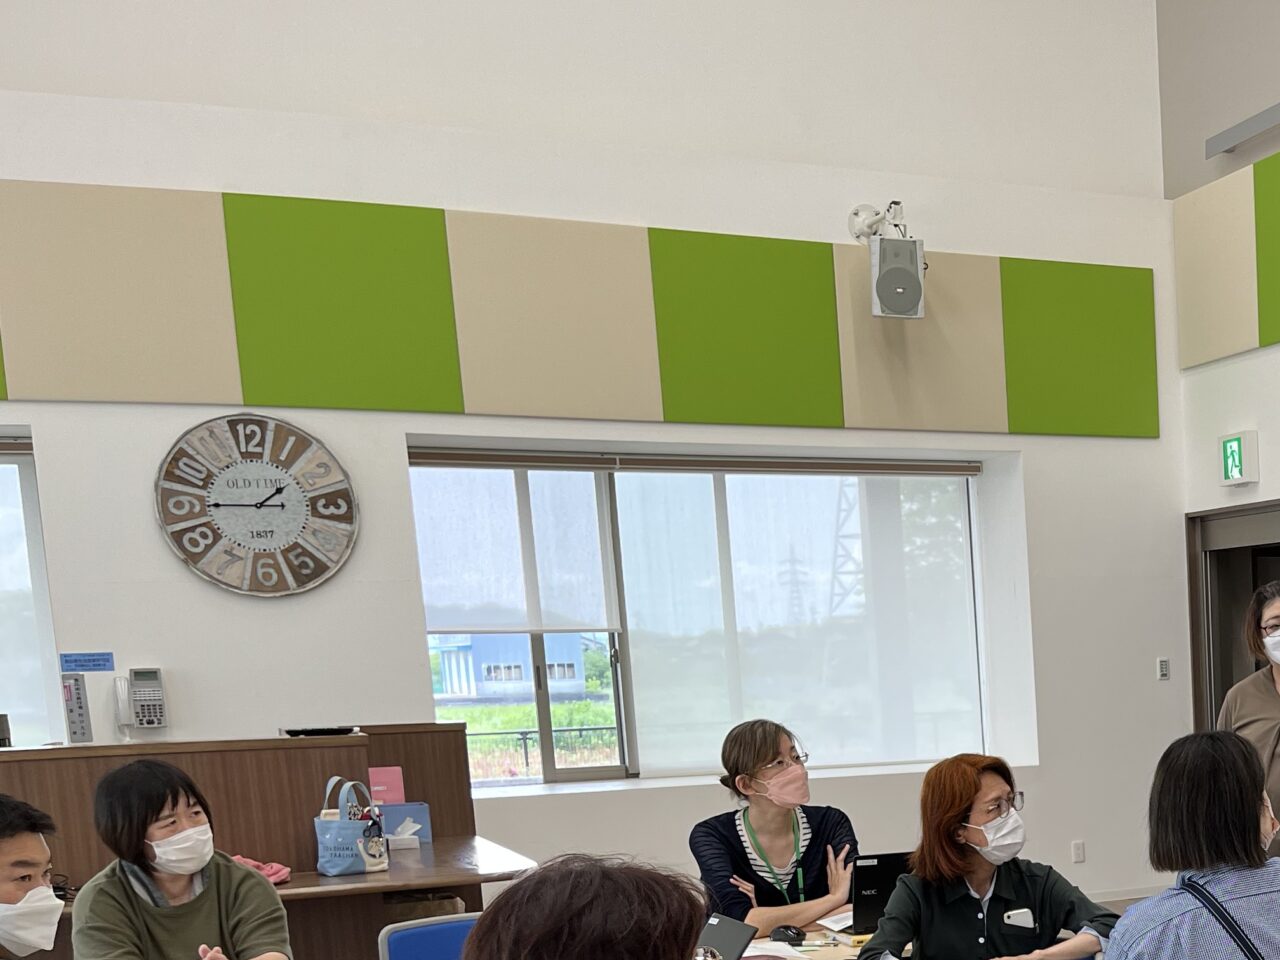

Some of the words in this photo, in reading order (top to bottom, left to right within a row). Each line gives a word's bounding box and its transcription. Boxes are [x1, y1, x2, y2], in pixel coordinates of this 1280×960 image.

[236, 422, 264, 454] 12
[279, 436, 296, 461] 1
[174, 456, 208, 488] 10
[226, 478, 251, 489] OLD
[302, 462, 331, 486] 2
[167, 495, 201, 515] 9
[316, 498, 348, 515] 3
[183, 526, 214, 553] 8
[250, 530, 275, 540] 1837
[216, 548, 244, 576] 7
[256, 558, 279, 587] 6
[288, 550, 315, 575] 5
